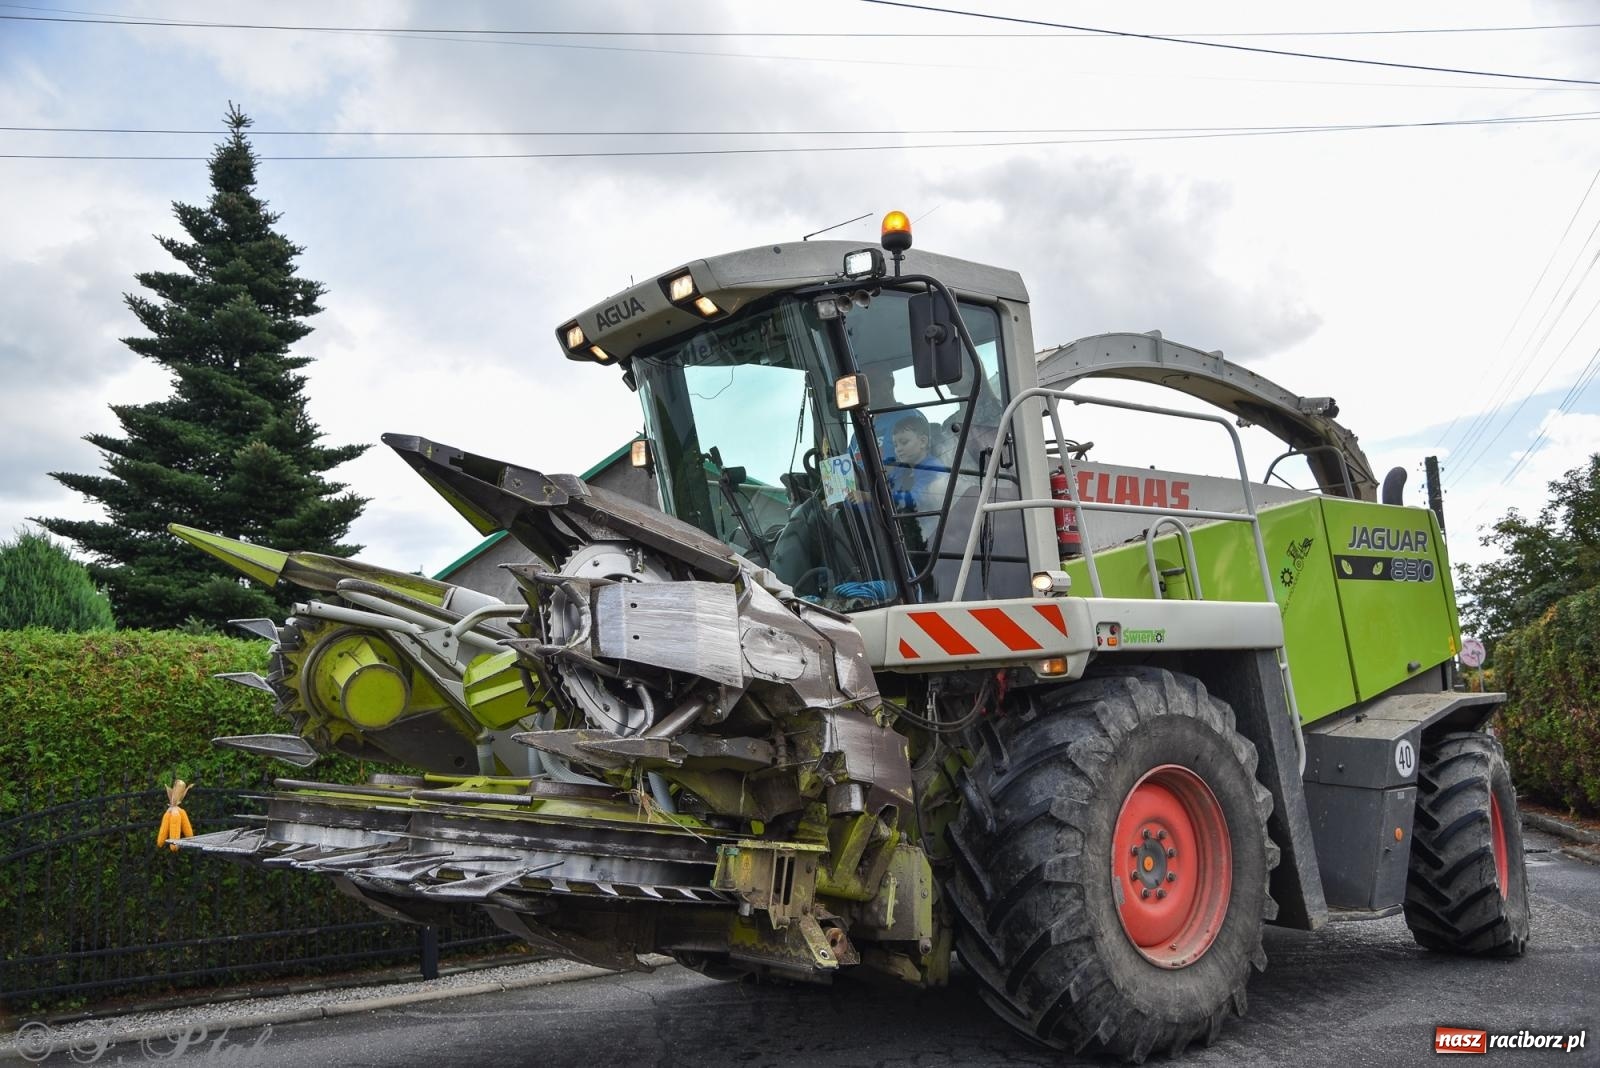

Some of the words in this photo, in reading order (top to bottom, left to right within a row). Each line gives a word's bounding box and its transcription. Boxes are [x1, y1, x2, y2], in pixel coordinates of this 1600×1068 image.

[1077, 470, 1190, 510] CLAAS
[1347, 525, 1429, 553] JAGUAR
[1391, 556, 1435, 583] 830
[1398, 745, 1412, 770] 40
